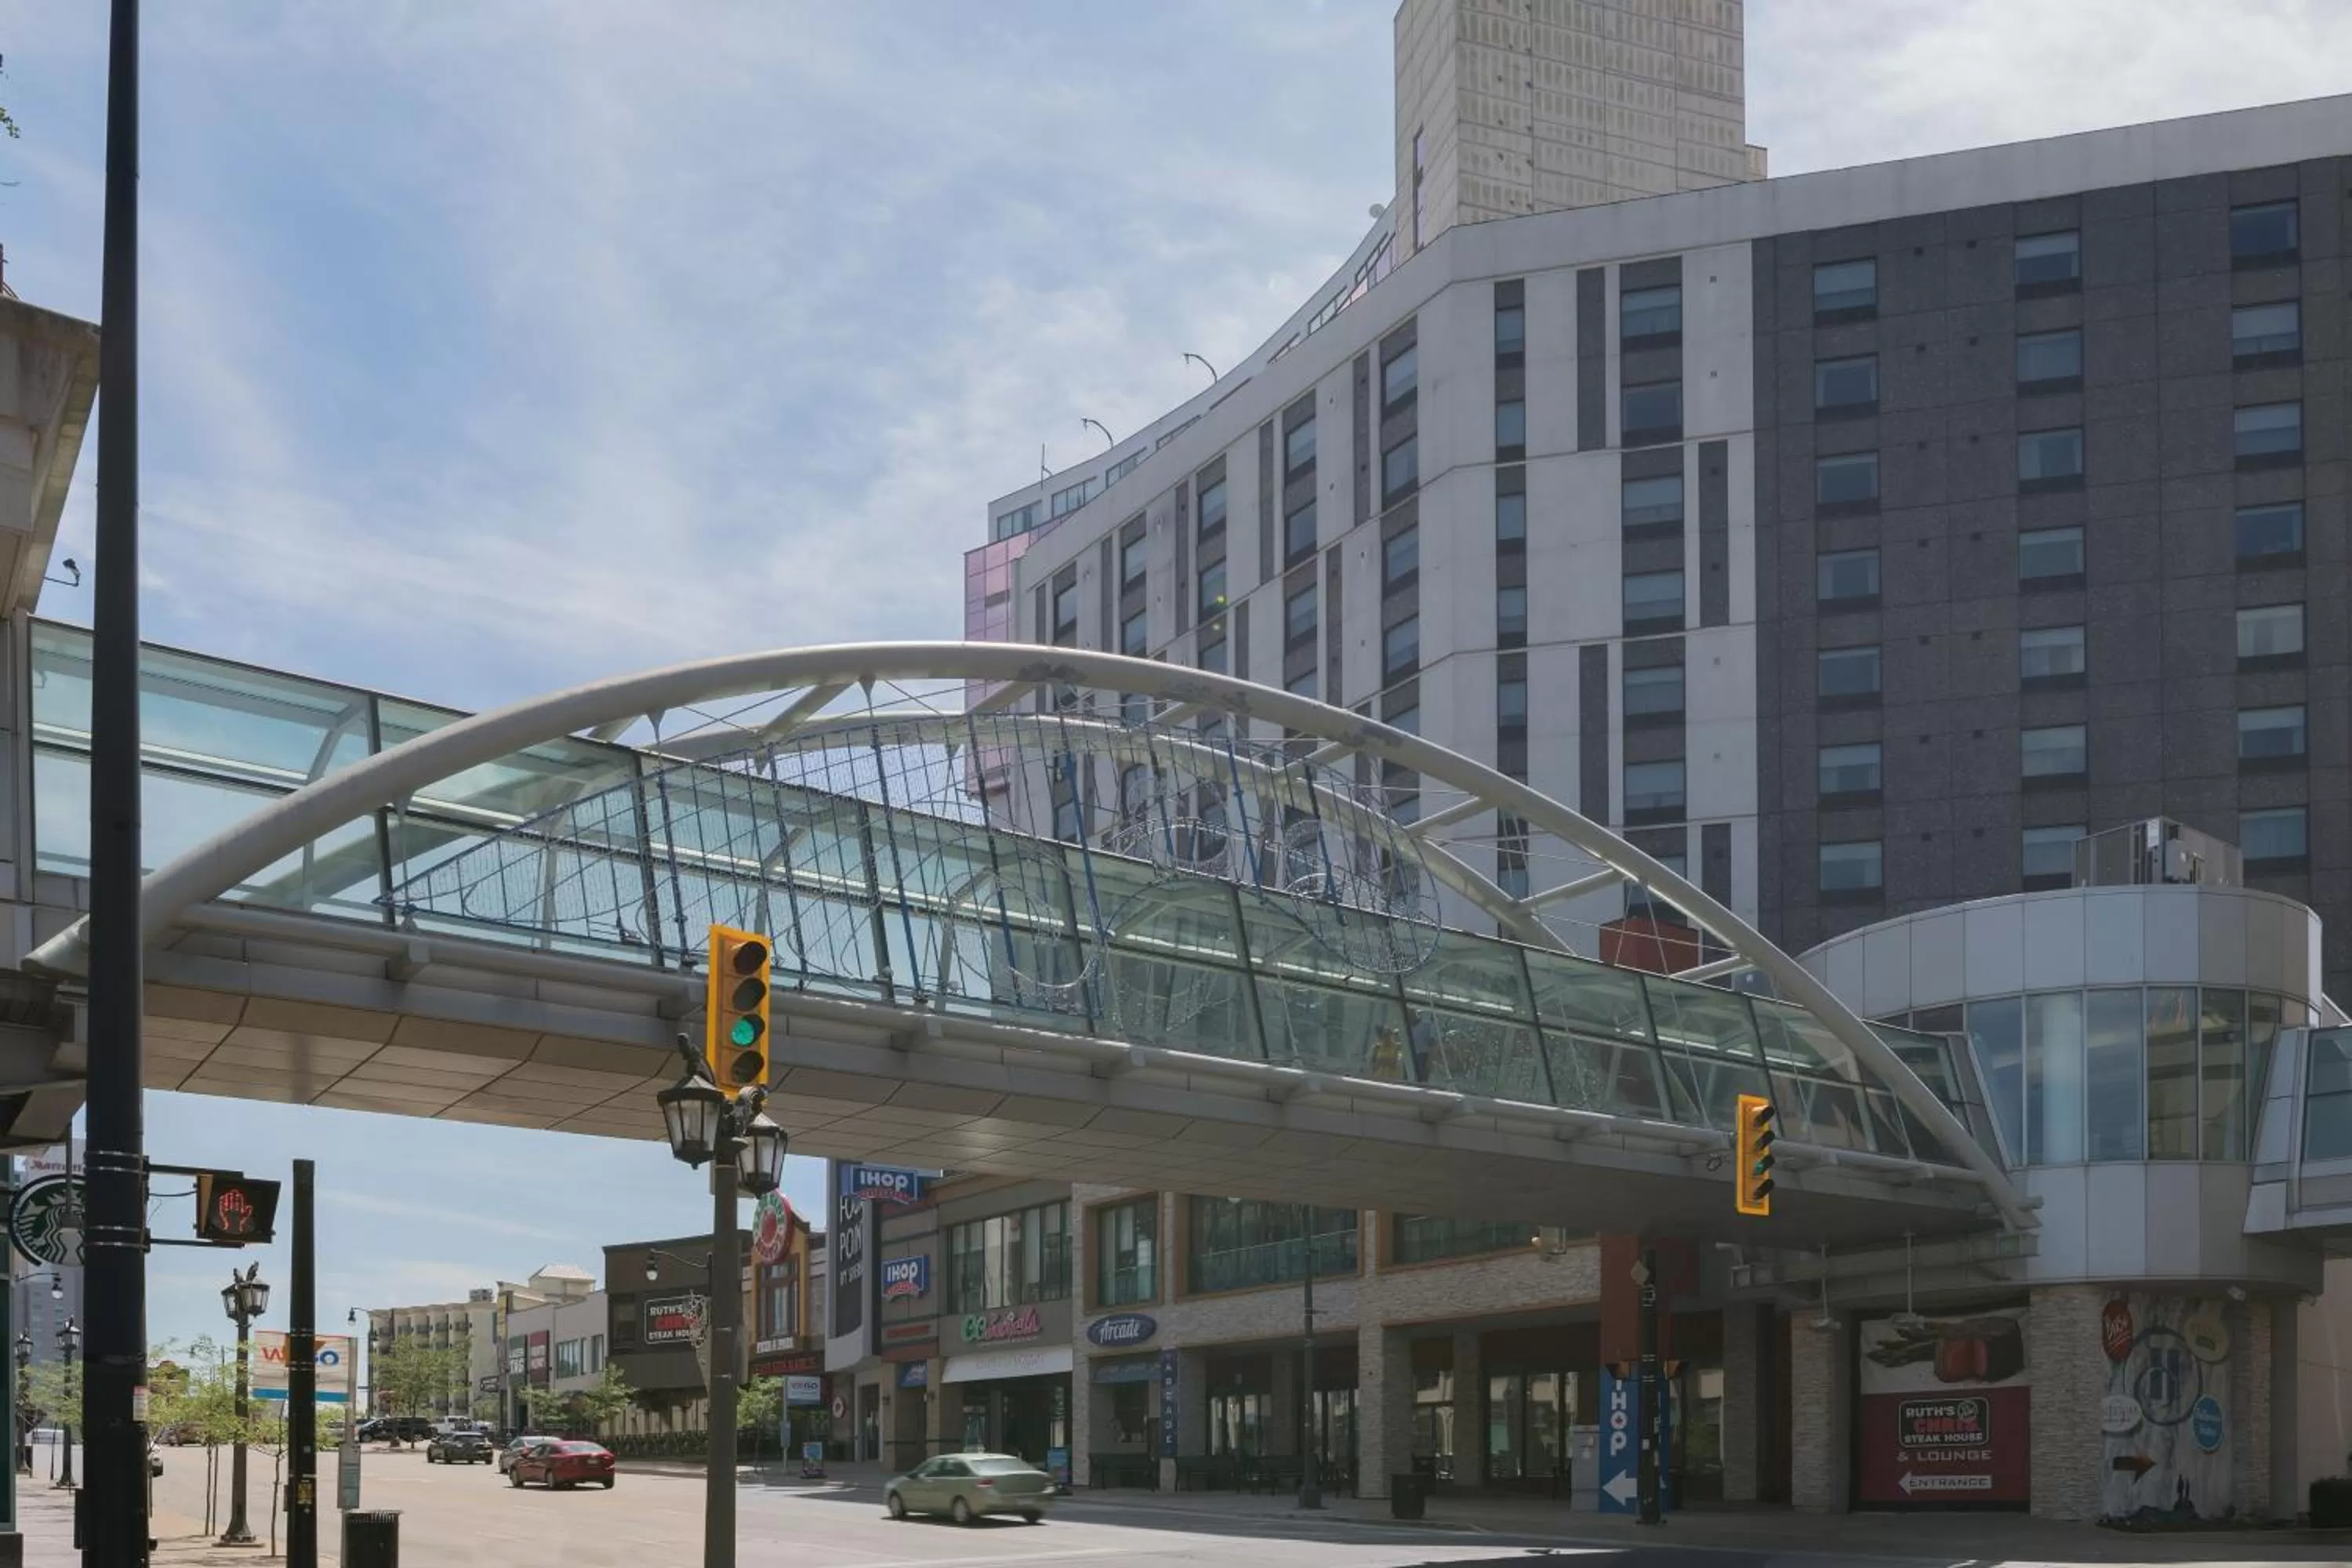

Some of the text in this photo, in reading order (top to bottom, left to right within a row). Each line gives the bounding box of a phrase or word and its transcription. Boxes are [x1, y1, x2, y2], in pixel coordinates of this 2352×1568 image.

[861, 1171, 908, 1190] IHOP
[887, 1261, 917, 1282] IHOP
[1101, 1319, 1141, 1342] Arcade
[1907, 1406, 1955, 1417] RUTH'S
[1904, 1433, 1982, 1443] STEAK HOUSE
[1898, 1450, 1991, 1461] & LOUNGE
